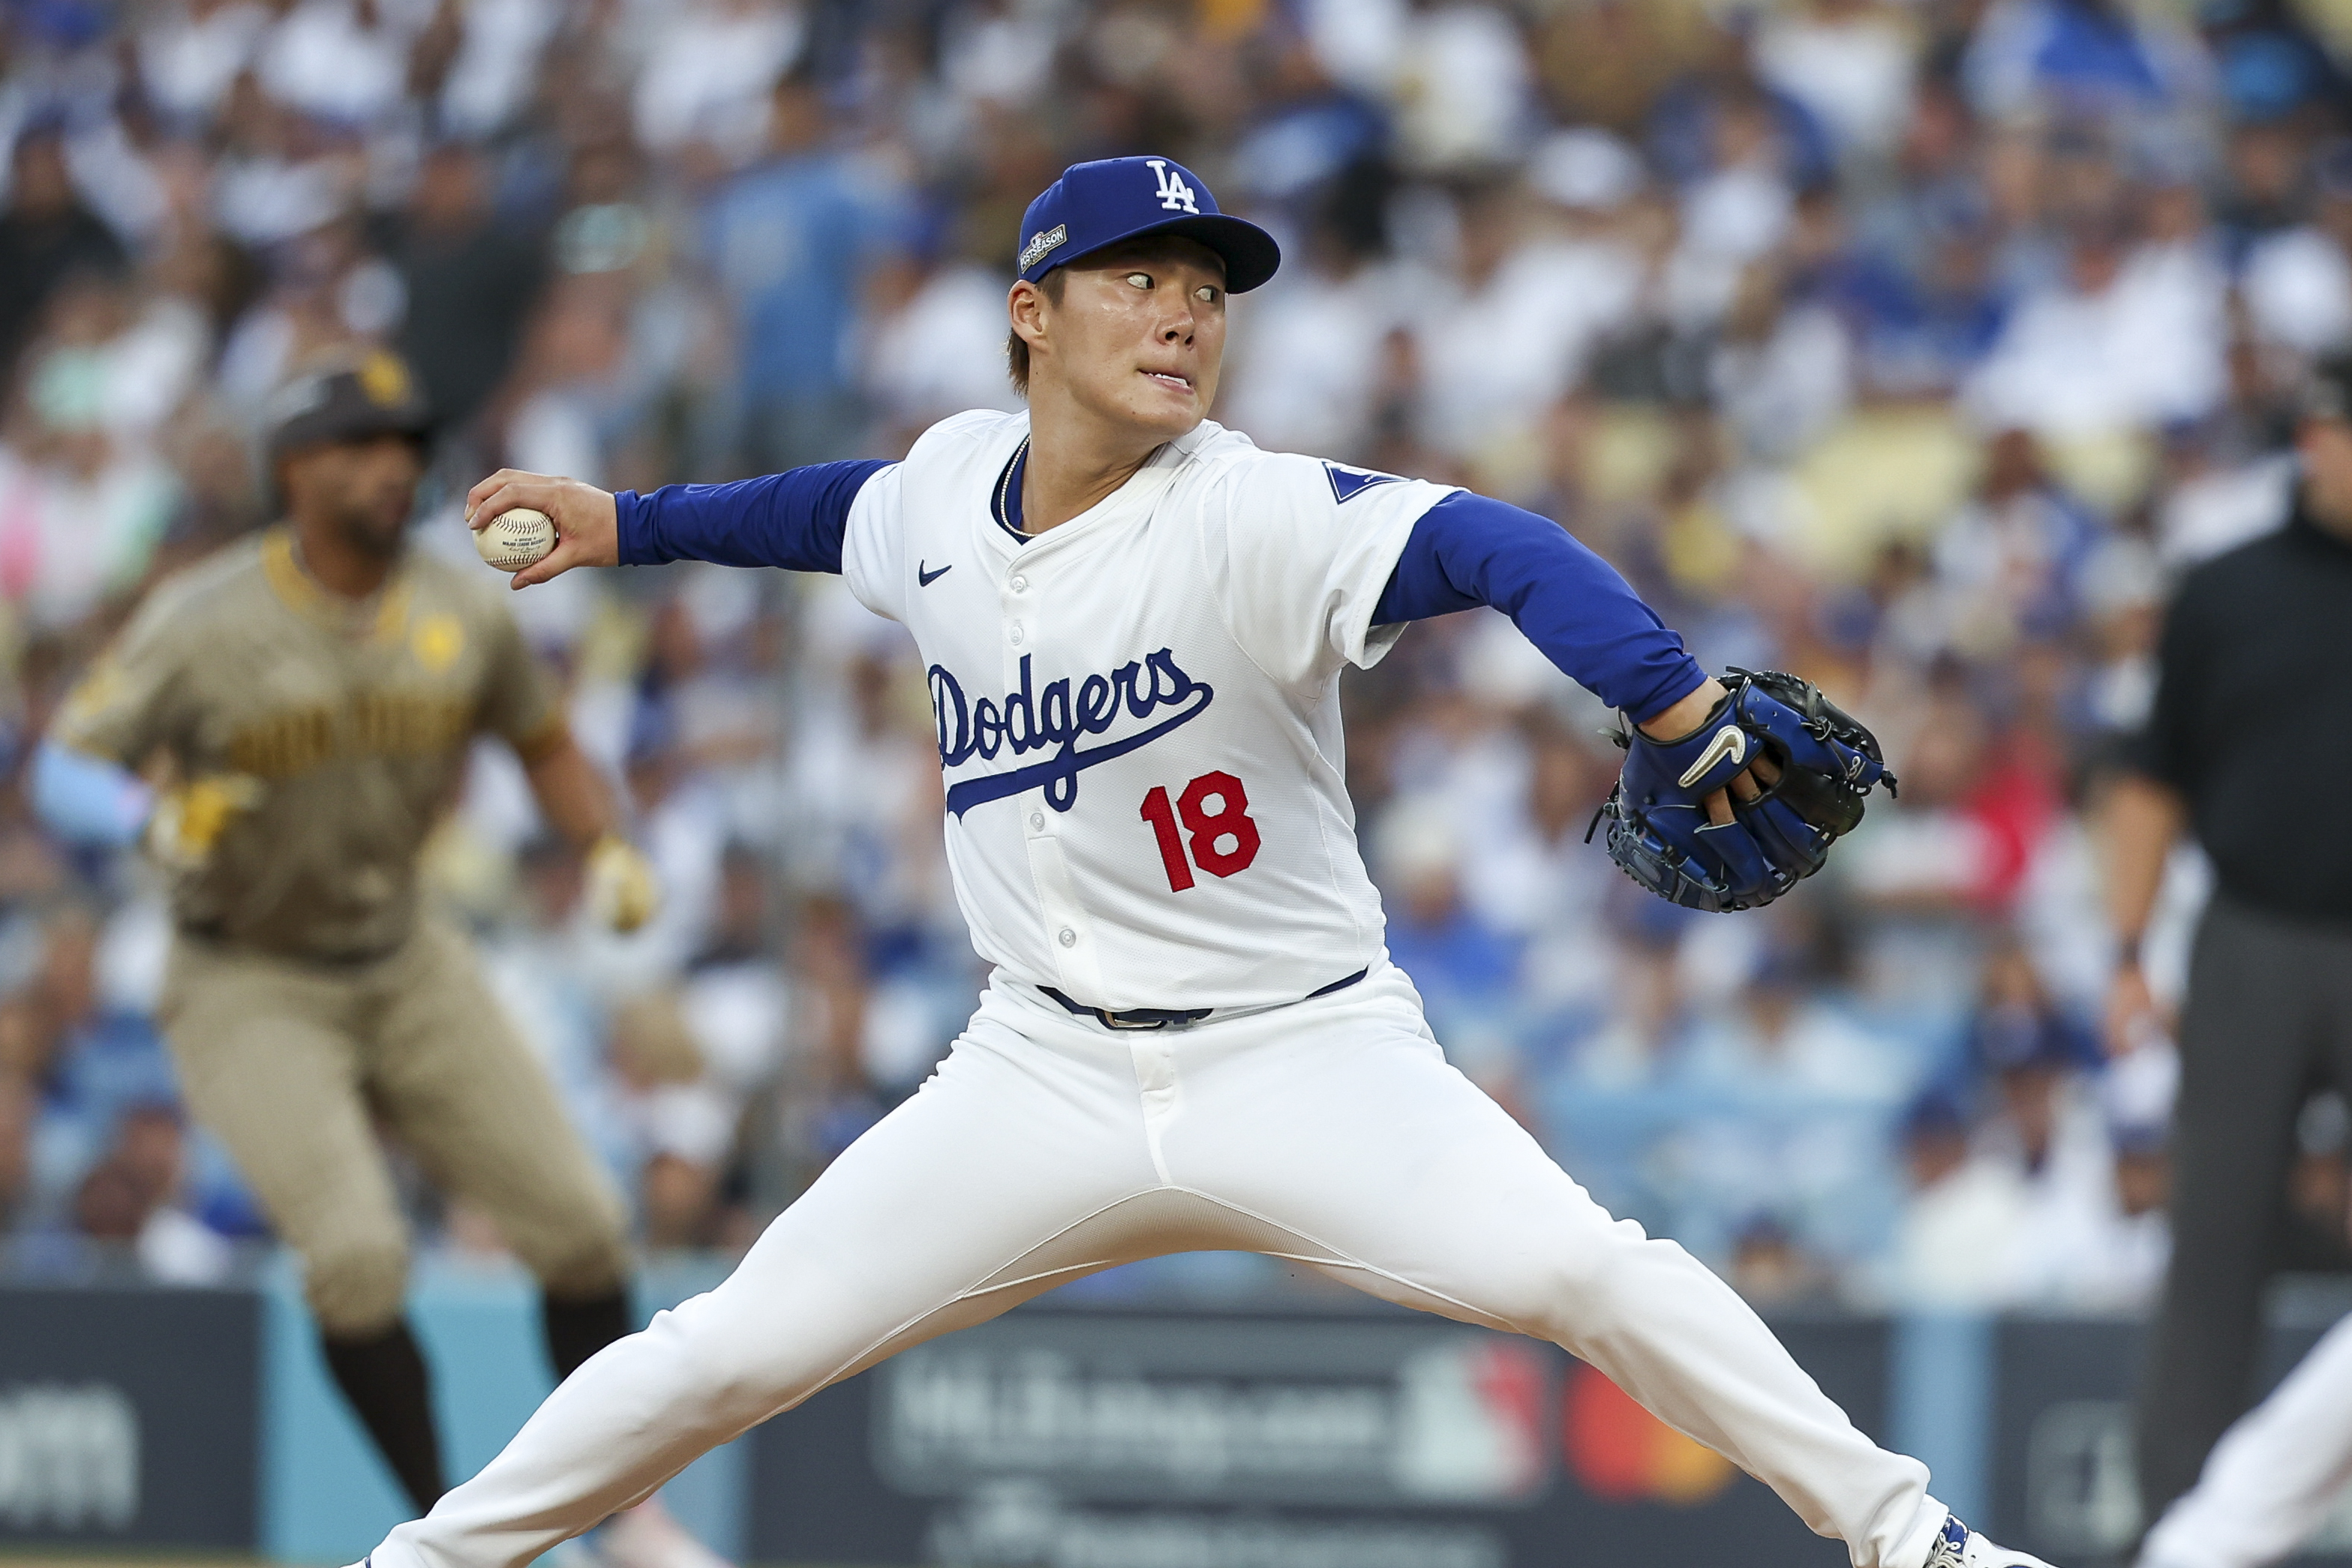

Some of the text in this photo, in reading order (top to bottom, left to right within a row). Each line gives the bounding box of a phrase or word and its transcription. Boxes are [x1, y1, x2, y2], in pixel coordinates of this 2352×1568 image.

[1146, 160, 1200, 215] LA
[1020, 229, 1064, 269] POSTSEASON
[530, 537, 546, 545] BASEBALL
[928, 647, 1214, 813] Dodgers
[1140, 770, 1261, 893] 18
